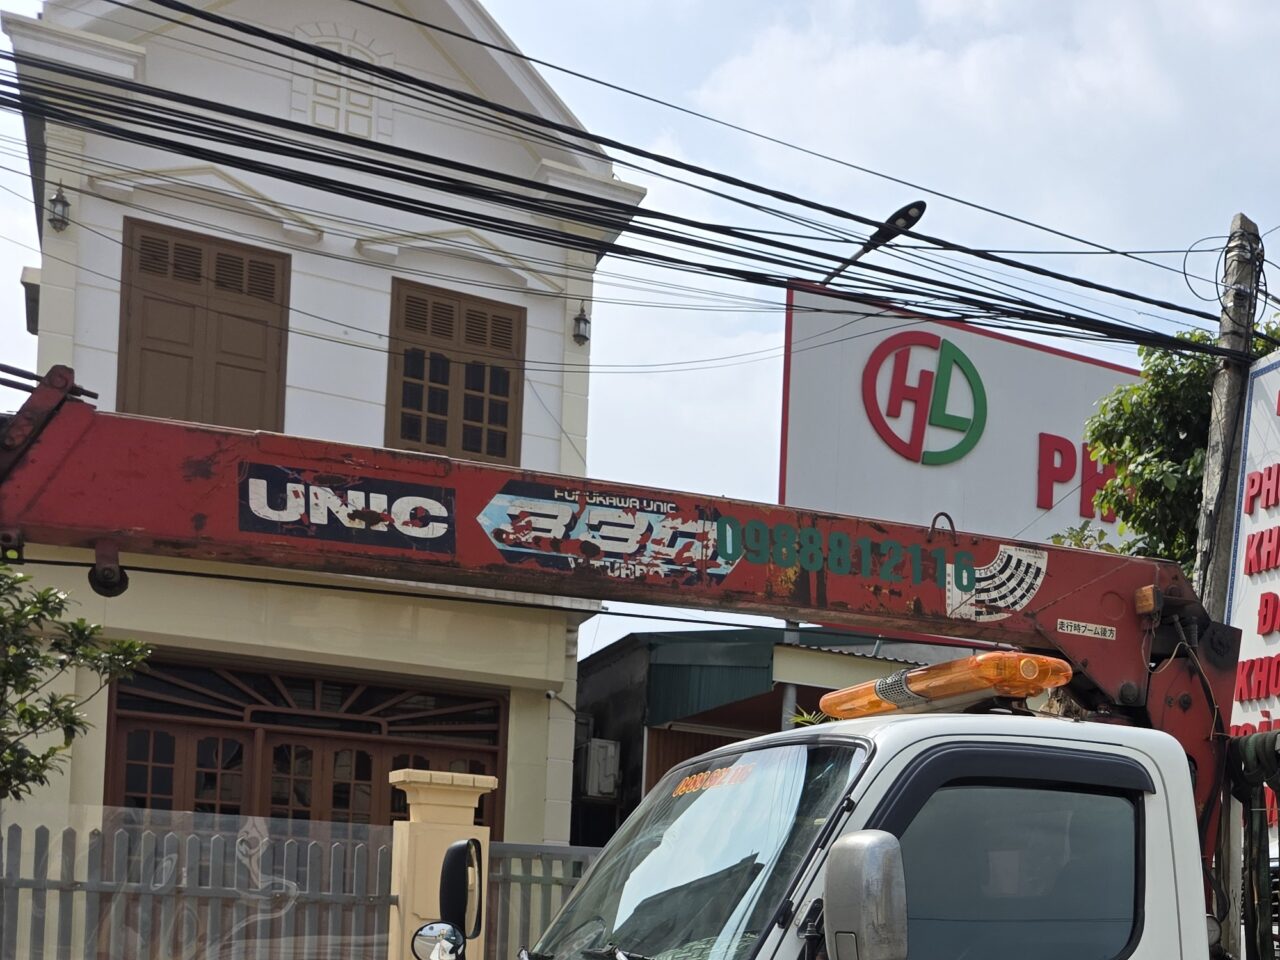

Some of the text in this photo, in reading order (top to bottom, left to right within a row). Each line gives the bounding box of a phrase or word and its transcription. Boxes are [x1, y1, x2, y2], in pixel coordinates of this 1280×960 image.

[247, 478, 449, 540] UNIC
[643, 499, 676, 513] UNIC
[716, 515, 976, 593] 0988812116
